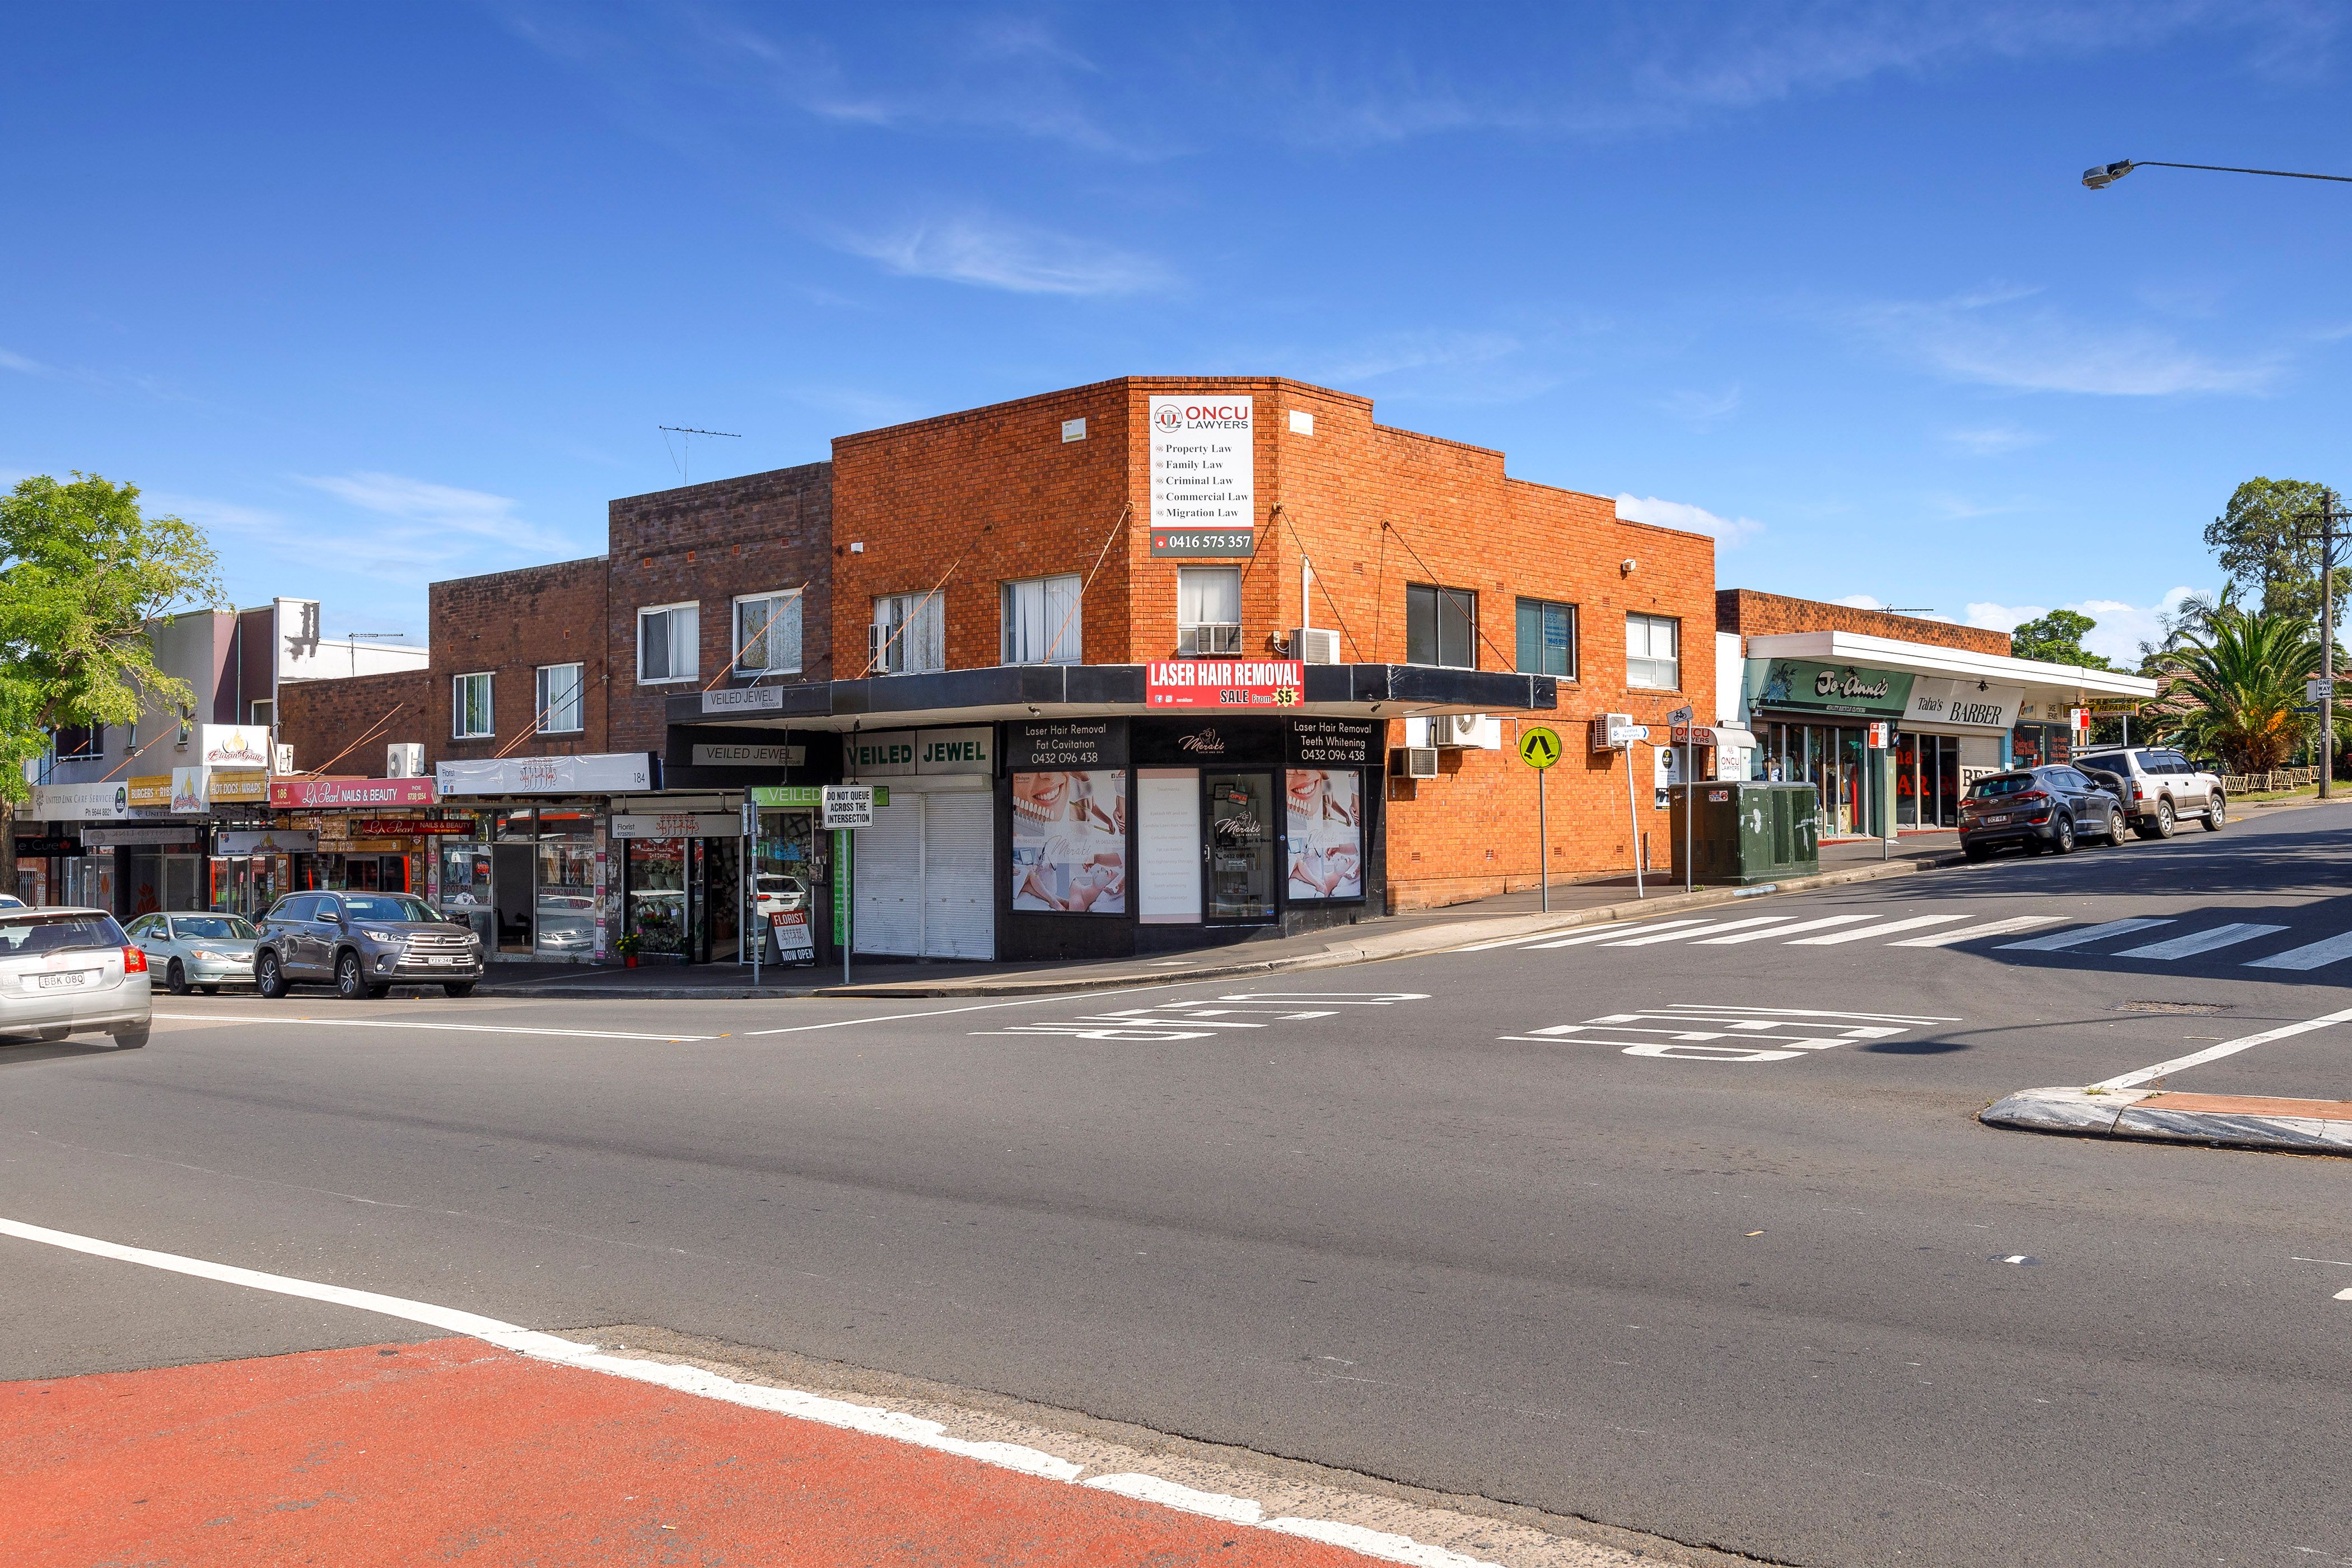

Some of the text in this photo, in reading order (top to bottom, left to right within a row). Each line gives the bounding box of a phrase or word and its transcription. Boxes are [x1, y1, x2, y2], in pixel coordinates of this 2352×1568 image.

[1186, 407, 1248, 420] ONCU
[1166, 444, 1232, 455] Property Law
[1166, 460, 1223, 470] Family Law
[1166, 477, 1209, 485] Criminal
[1166, 509, 1214, 519] Migration
[1169, 536, 1250, 548] 0416 575 357
[1151, 663, 1300, 686] LASER HAIR REMOVAL
[711, 689, 773, 705] VEILED JEWEL
[1220, 689, 1292, 704] SALE From $5
[1918, 697, 1943, 711] Taha's
[1949, 702, 2002, 725] BARBER
[1026, 724, 1106, 736] Laser Hair Removal
[1294, 721, 1371, 733] Laser Hair Removal
[1037, 739, 1094, 749] Fat Cavitation
[1178, 735, 1224, 752] Meraki
[1301, 736, 1365, 749] Teeth Whitening
[707, 748, 793, 759] VEILED JEWEL
[846, 741, 986, 765] VEILED JEWEL
[1032, 753, 1098, 764] 0432 096 438
[1301, 749, 1365, 760] 0432 096 438
[634, 773, 645, 783] 184
[131, 786, 172, 799] BURGERS RIBS
[211, 783, 260, 795] HOT DOGS WRAPS
[277, 788, 287, 799] 186
[318, 782, 340, 803] Pearl
[342, 788, 361, 802] NAILS
[363, 789, 368, 801] &
[370, 788, 398, 801] BEAUTY
[768, 788, 821, 801] VEILED
[45, 794, 114, 804] UNITED LINK CARE SERVICES
[827, 791, 869, 801] DO NOT QUEUE
[830, 802, 866, 811] ACROSS THE
[828, 814, 870, 823] INTERSECTION
[387, 820, 414, 833] Pearl
[1215, 819, 1261, 834] Meraki
[32, 840, 59, 850] Cure
[539, 886, 581, 896] ACRYLIC NAILS
[570, 899, 593, 908] WAXIN
[773, 913, 804, 925] FLORIST
[782, 949, 814, 961] NOW OPEN
[45, 977, 62, 986] BBK
